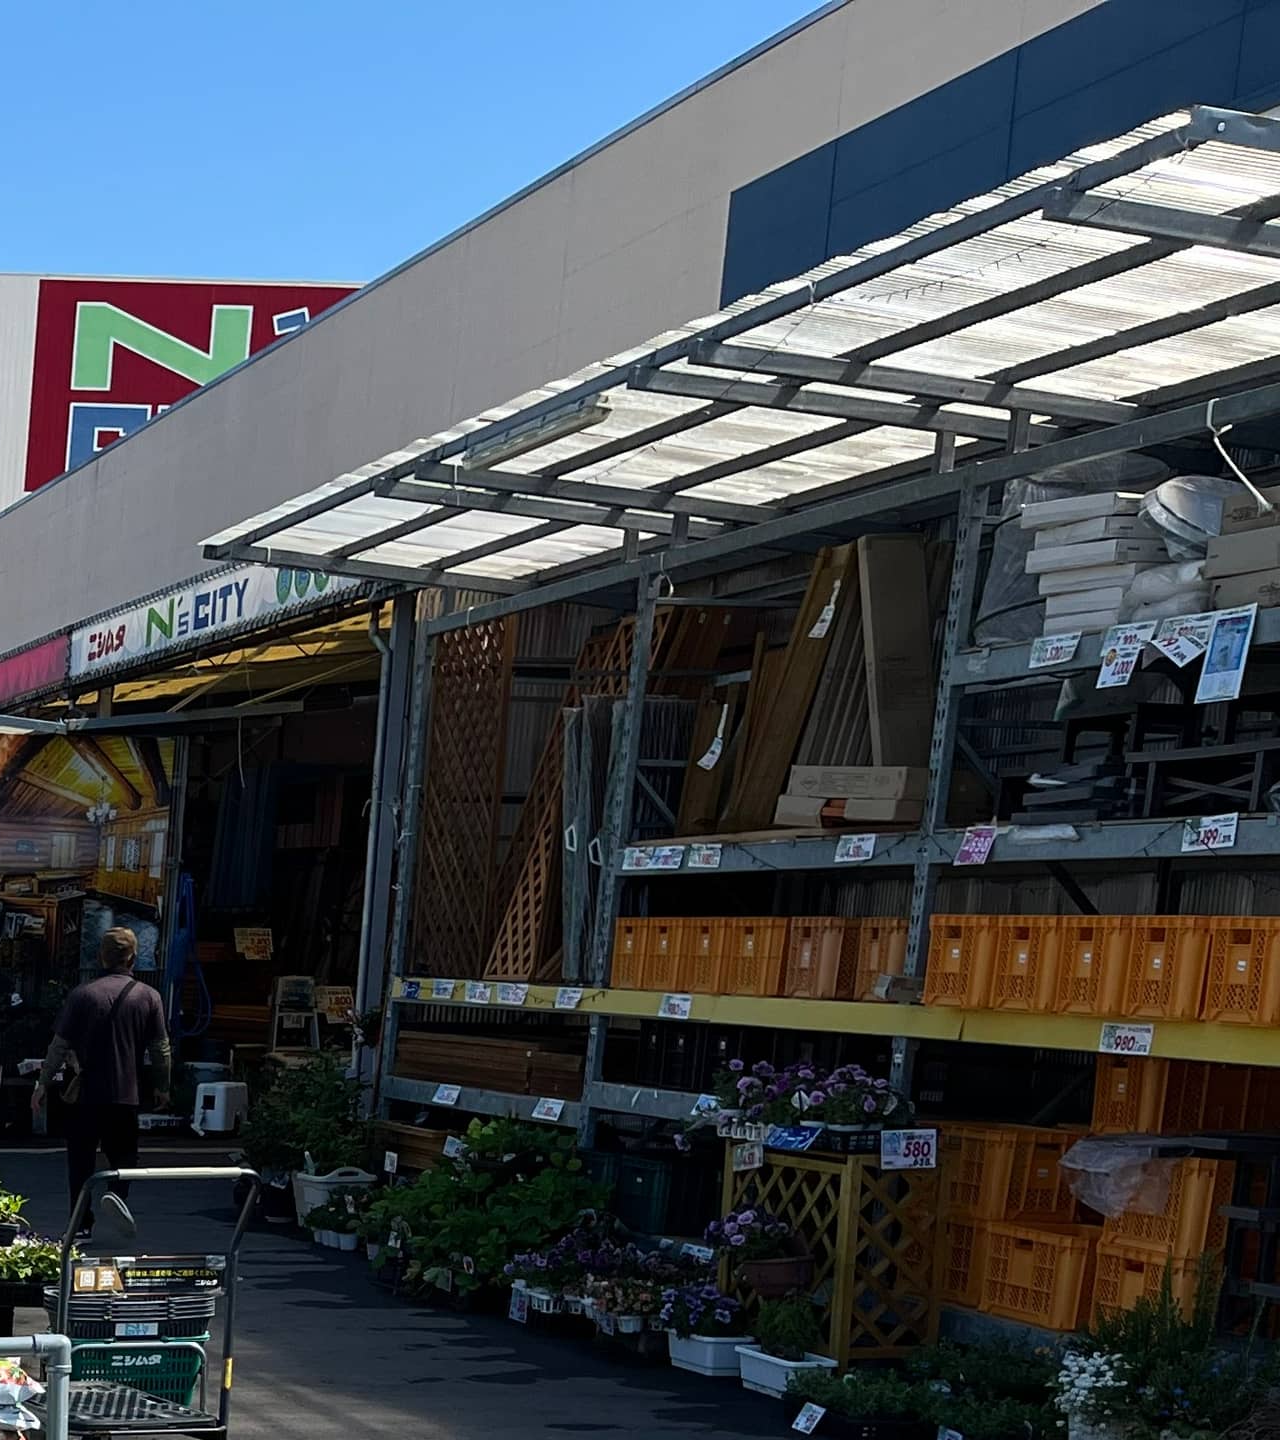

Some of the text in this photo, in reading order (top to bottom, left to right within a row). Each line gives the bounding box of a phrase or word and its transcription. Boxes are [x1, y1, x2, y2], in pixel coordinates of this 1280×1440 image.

[70, 301, 309, 388] N'
[145, 595, 190, 648] N's
[193, 578, 249, 630] CITY
[87, 624, 126, 662] ニシムタ
[1113, 1035, 1136, 1052] 980
[903, 1141, 931, 1158] 580
[79, 1269, 116, 1288] 園芸
[111, 1353, 163, 1367] ニシムタ
